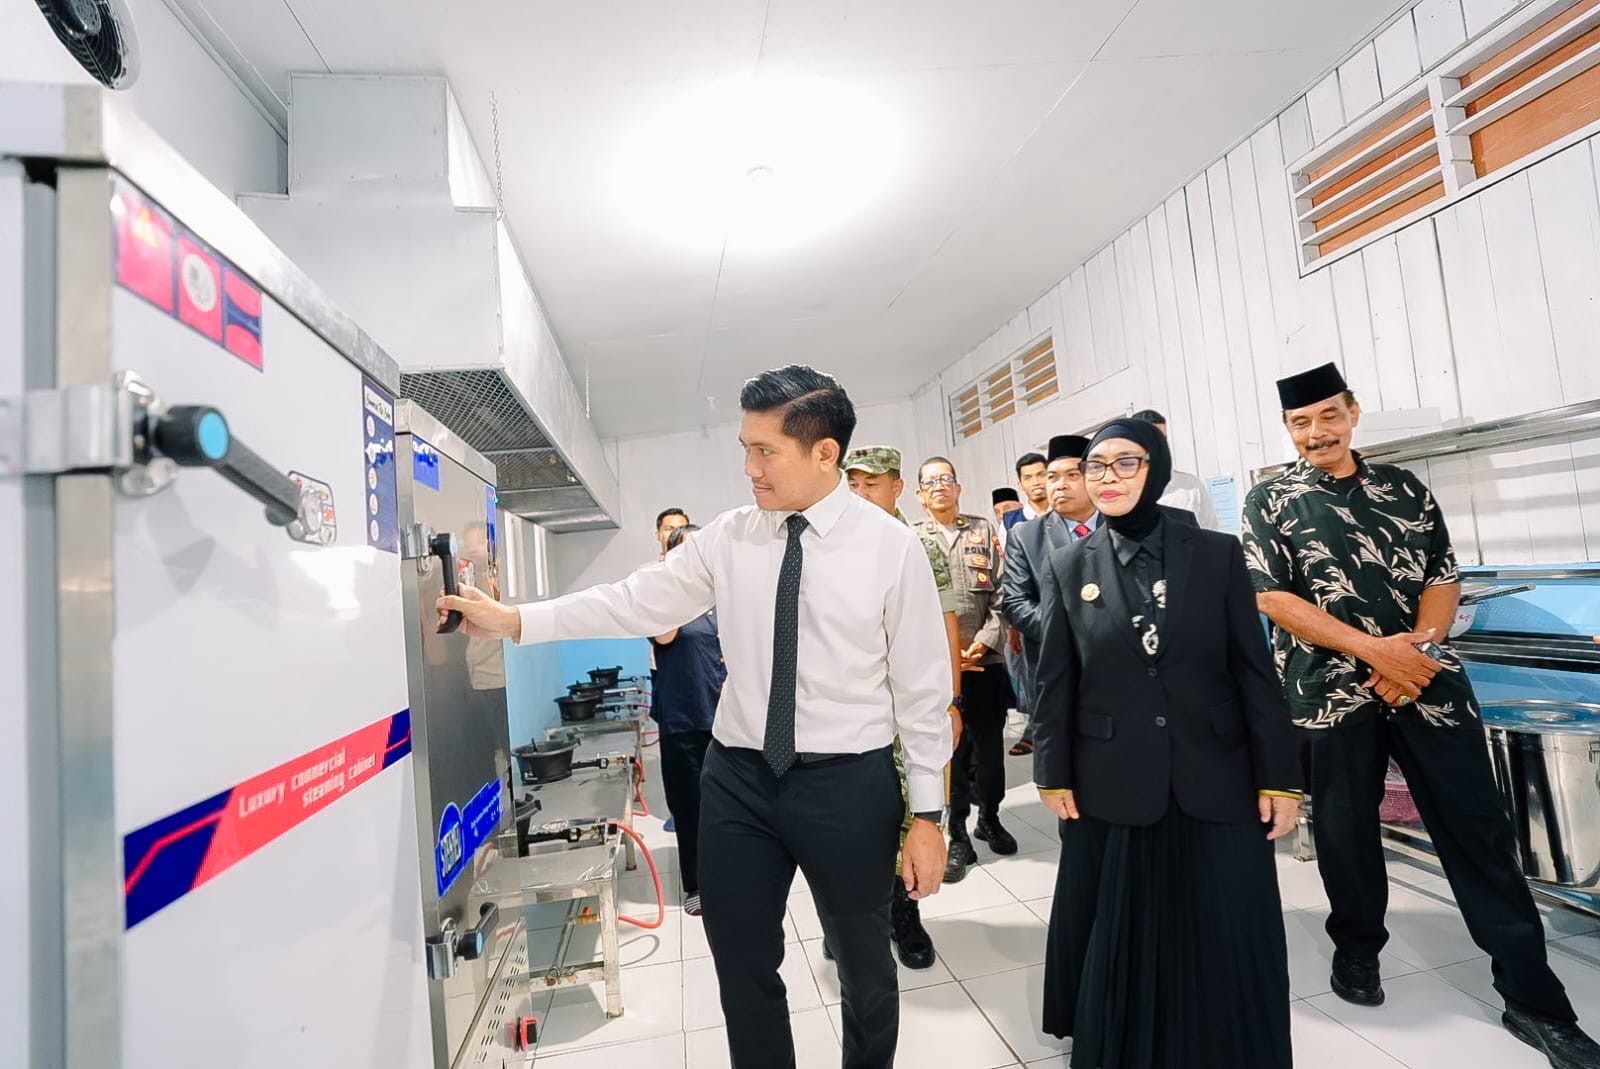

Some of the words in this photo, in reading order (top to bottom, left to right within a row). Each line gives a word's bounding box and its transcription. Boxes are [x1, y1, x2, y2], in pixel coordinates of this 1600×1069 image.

[239, 782, 285, 818] Luxury
[291, 747, 346, 792] commercial
[302, 771, 345, 808] steaming
[348, 753, 376, 780] cabinet
